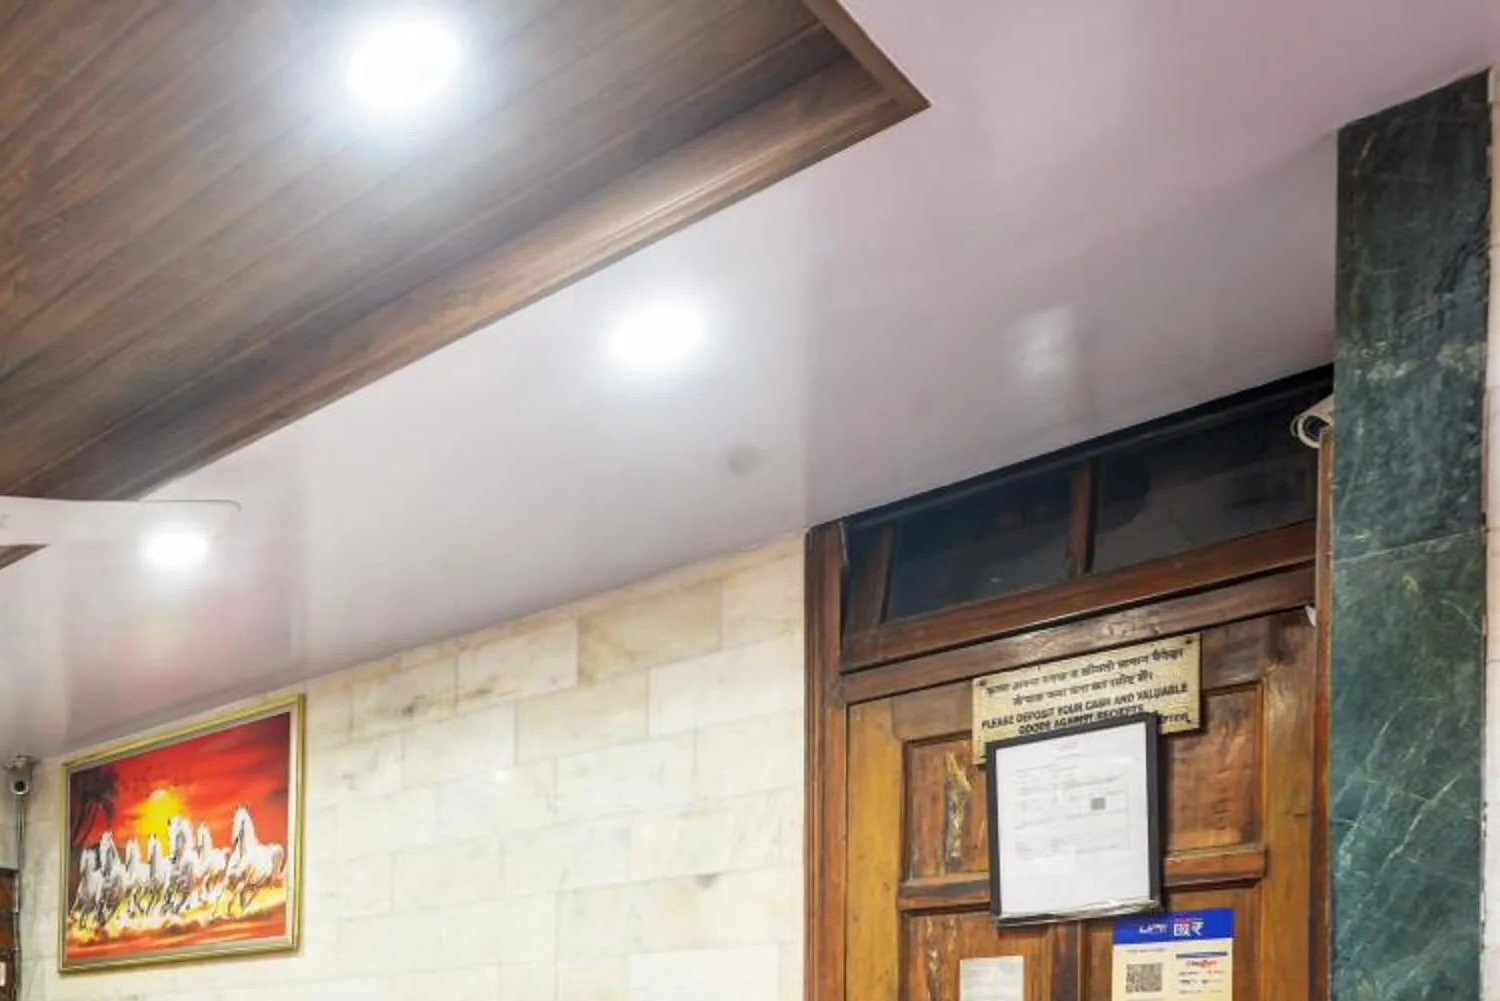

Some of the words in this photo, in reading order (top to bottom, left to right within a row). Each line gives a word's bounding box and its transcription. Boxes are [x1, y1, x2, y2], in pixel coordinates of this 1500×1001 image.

[981, 715, 1015, 730] PLEASE
[1016, 707, 1055, 722] DEPOSIT
[1057, 702, 1083, 715] YOUR
[1114, 692, 1135, 705] AND
[1136, 683, 1189, 699] VALUABLE
